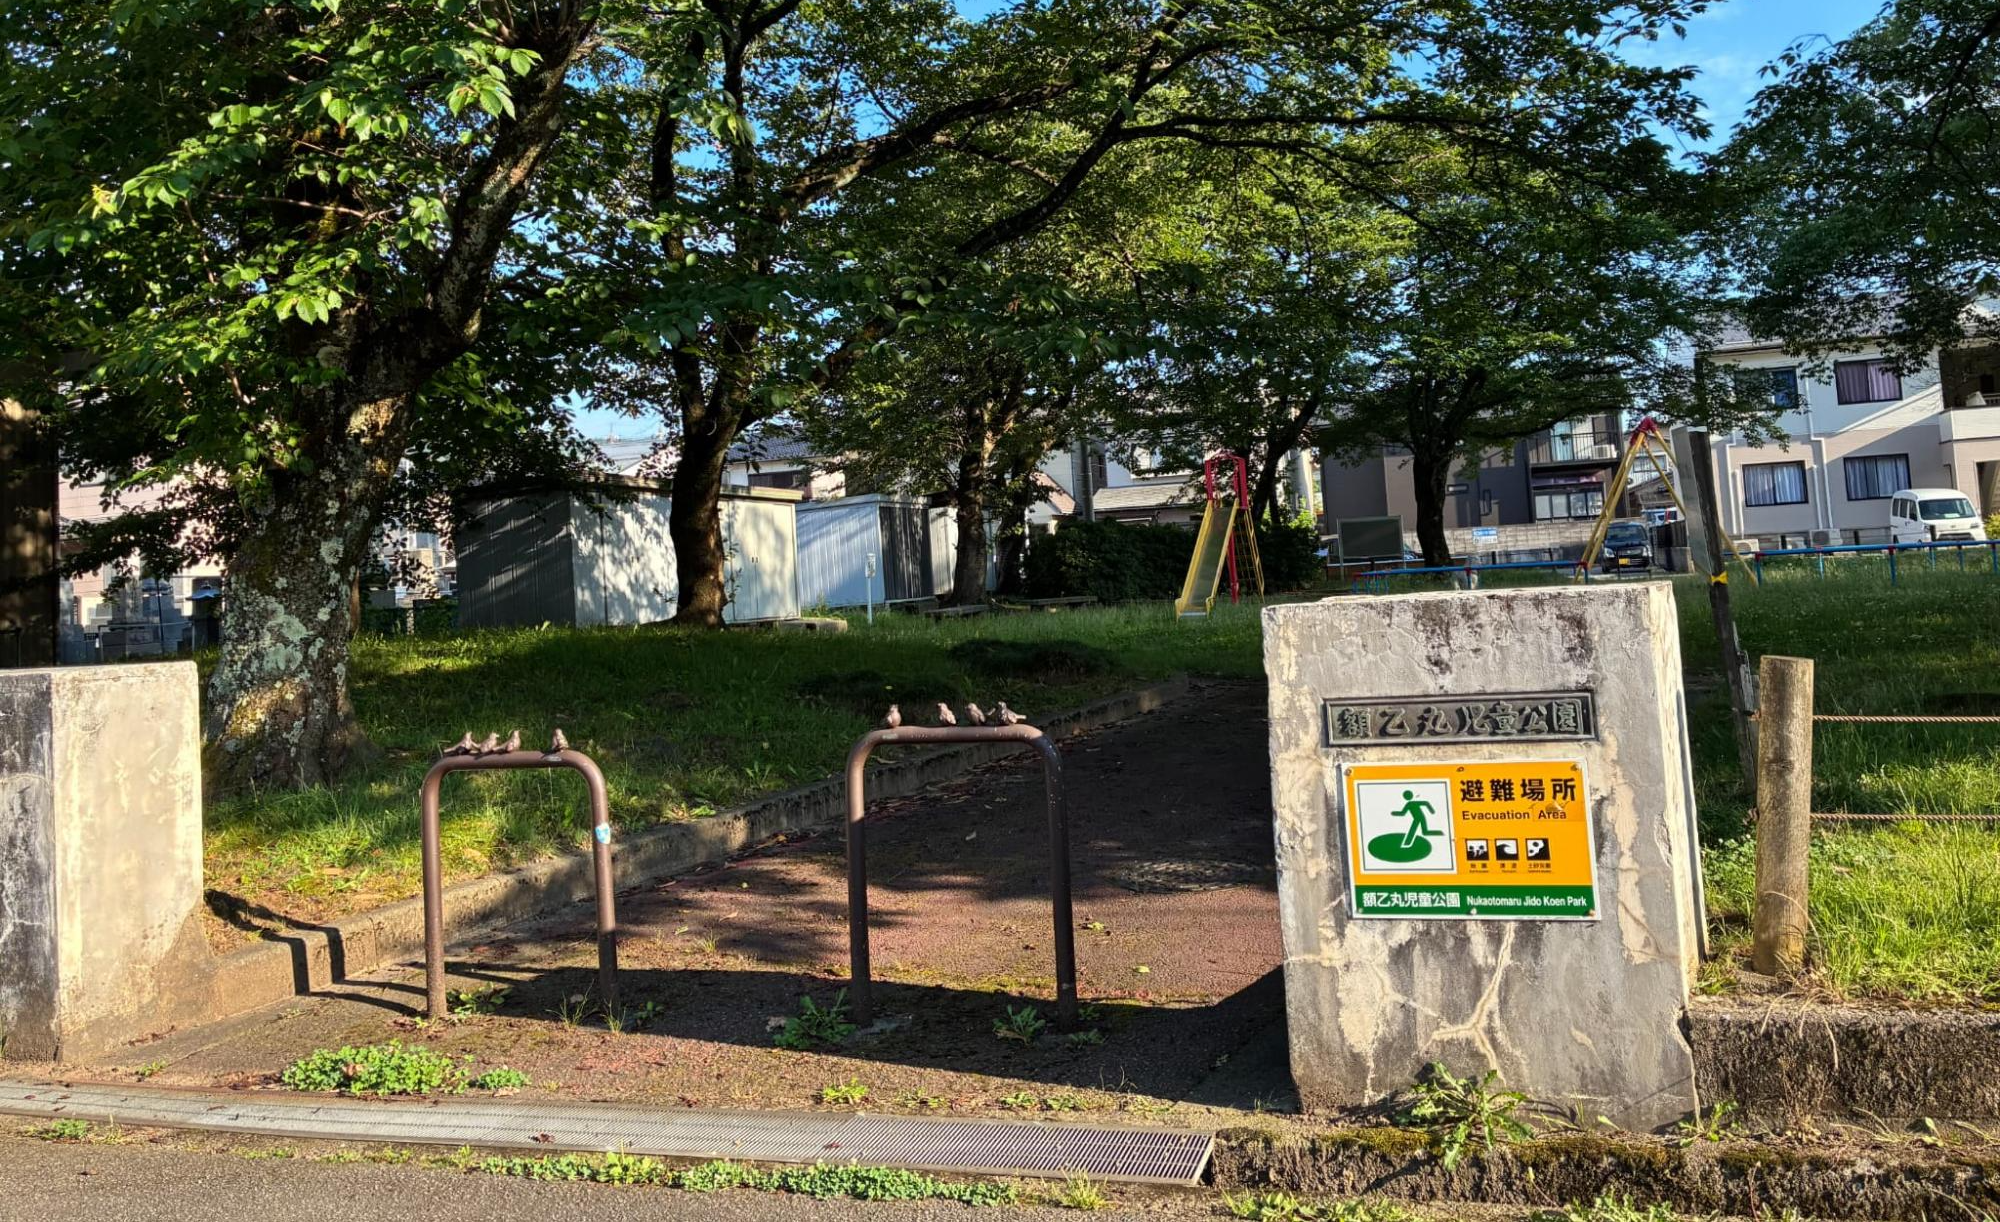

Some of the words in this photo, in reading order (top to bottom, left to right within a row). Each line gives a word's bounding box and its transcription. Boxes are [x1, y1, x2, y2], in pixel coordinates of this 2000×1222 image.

[1338, 699, 1584, 738] 額乙丸児童公園
[1460, 777, 1576, 802] 避難場所
[1462, 810, 1530, 820] Evacuation
[1538, 810, 1567, 819] Area
[1362, 891, 1460, 908] 額乙丸児童公園
[1467, 896, 1522, 906] Nukaotomaru
[1523, 895, 1542, 906] Jido
[1543, 895, 1566, 906] Koen
[1567, 895, 1587, 906] Park
